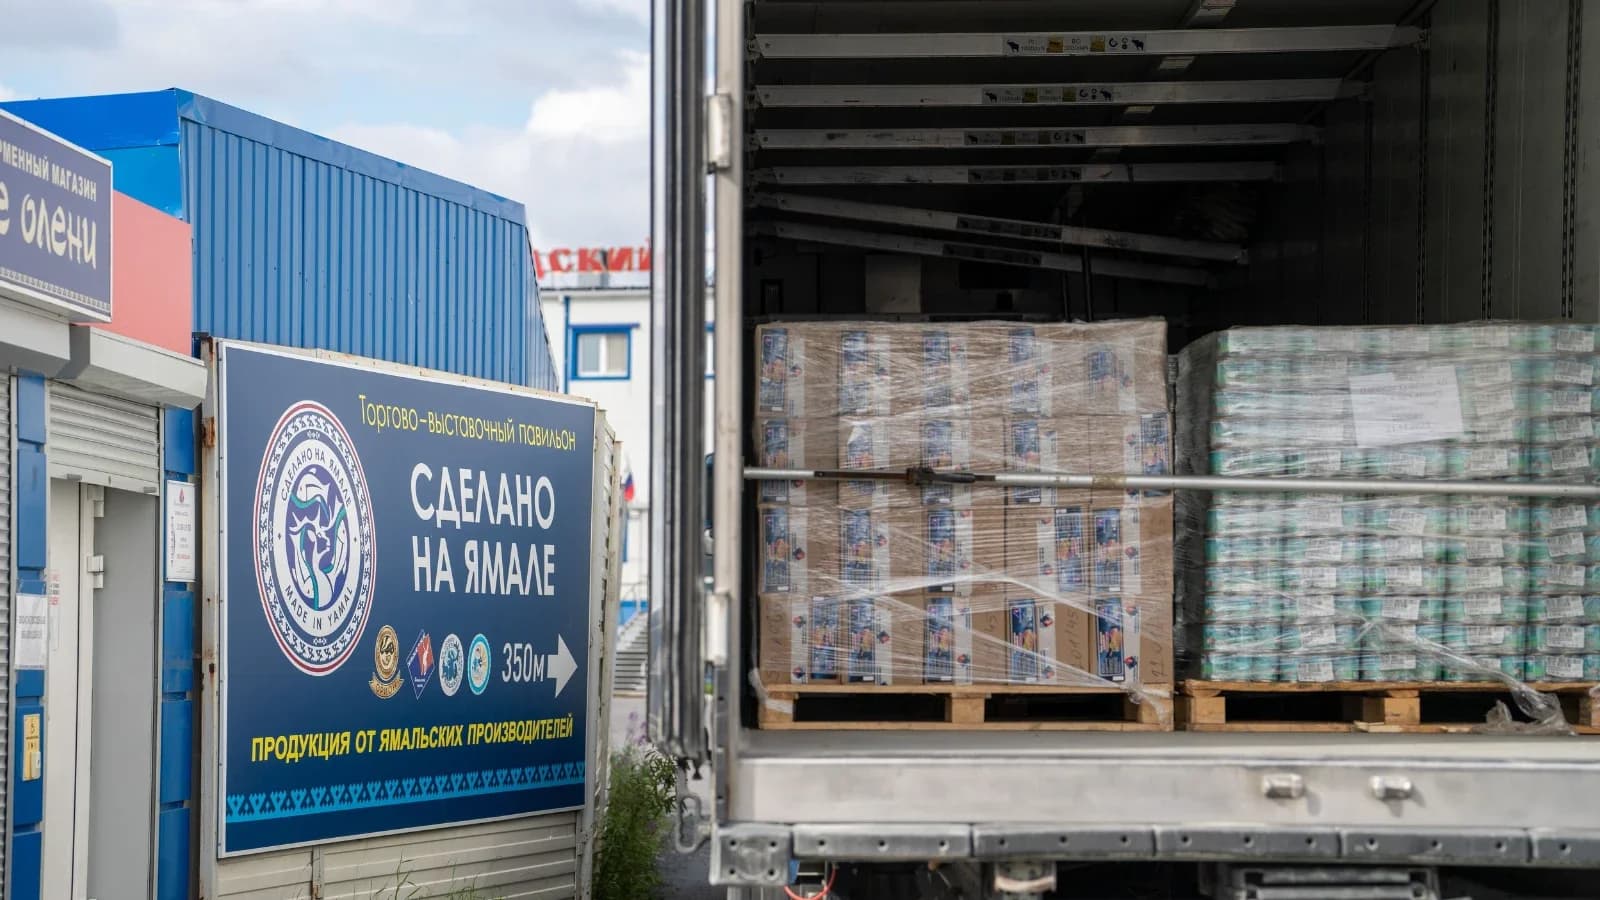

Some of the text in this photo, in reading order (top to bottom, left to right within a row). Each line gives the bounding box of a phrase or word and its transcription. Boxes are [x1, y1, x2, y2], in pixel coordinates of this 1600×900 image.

[51, 163, 97, 203] МАГАЗИН
[20, 193, 97, 270] олени
[359, 394, 576, 451] Торгово-выставочный павильон
[280, 448, 353, 508] СДЕЛАНО НА ЯМАЛЕ
[410, 462, 555, 529] СДЕЛАНО
[412, 536, 555, 596] НА ЯМАЛЕ
[284, 584, 354, 631] MADE IN YAMAL
[501, 642, 545, 684] 350м
[251, 713, 574, 763] ПРОДУКЦИЯ ОТ ЯМАЛЬСКИХ ПРОИЗВОДИТЕЛЕЙ
